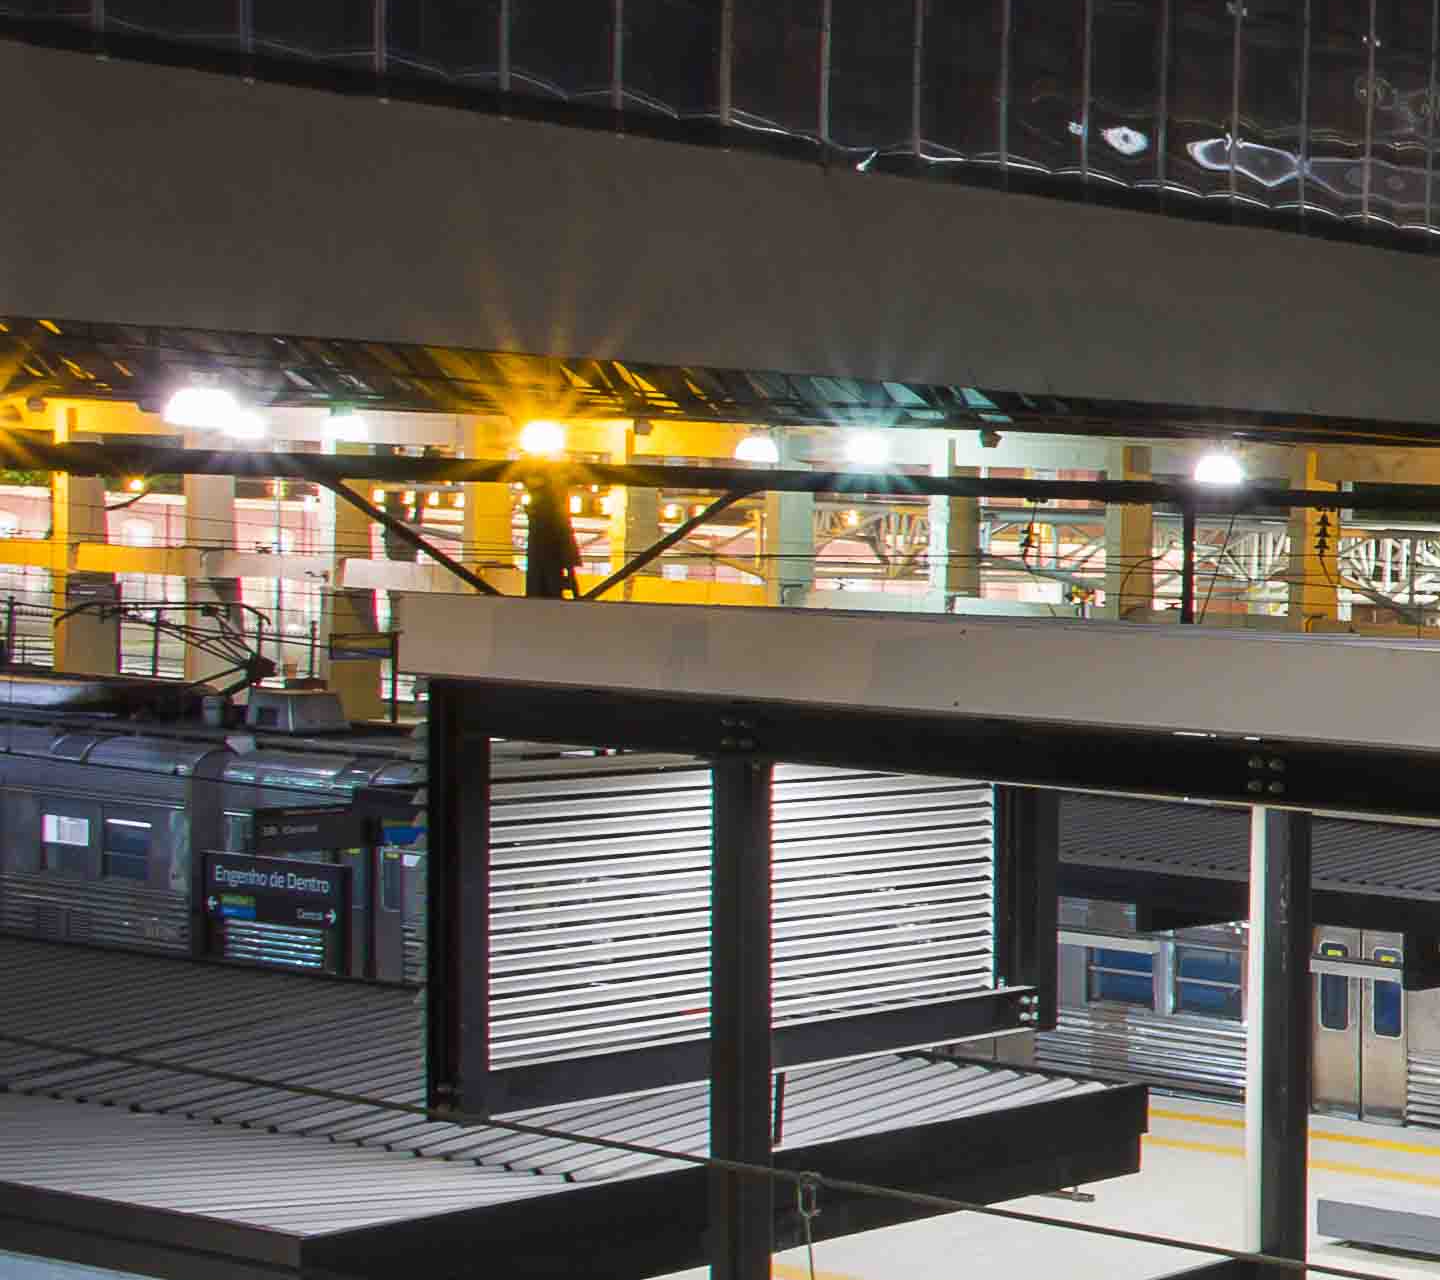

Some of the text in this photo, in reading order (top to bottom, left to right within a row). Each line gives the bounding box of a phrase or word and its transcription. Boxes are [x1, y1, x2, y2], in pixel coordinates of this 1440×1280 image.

[215, 864, 330, 894] Engenho de Dentro
